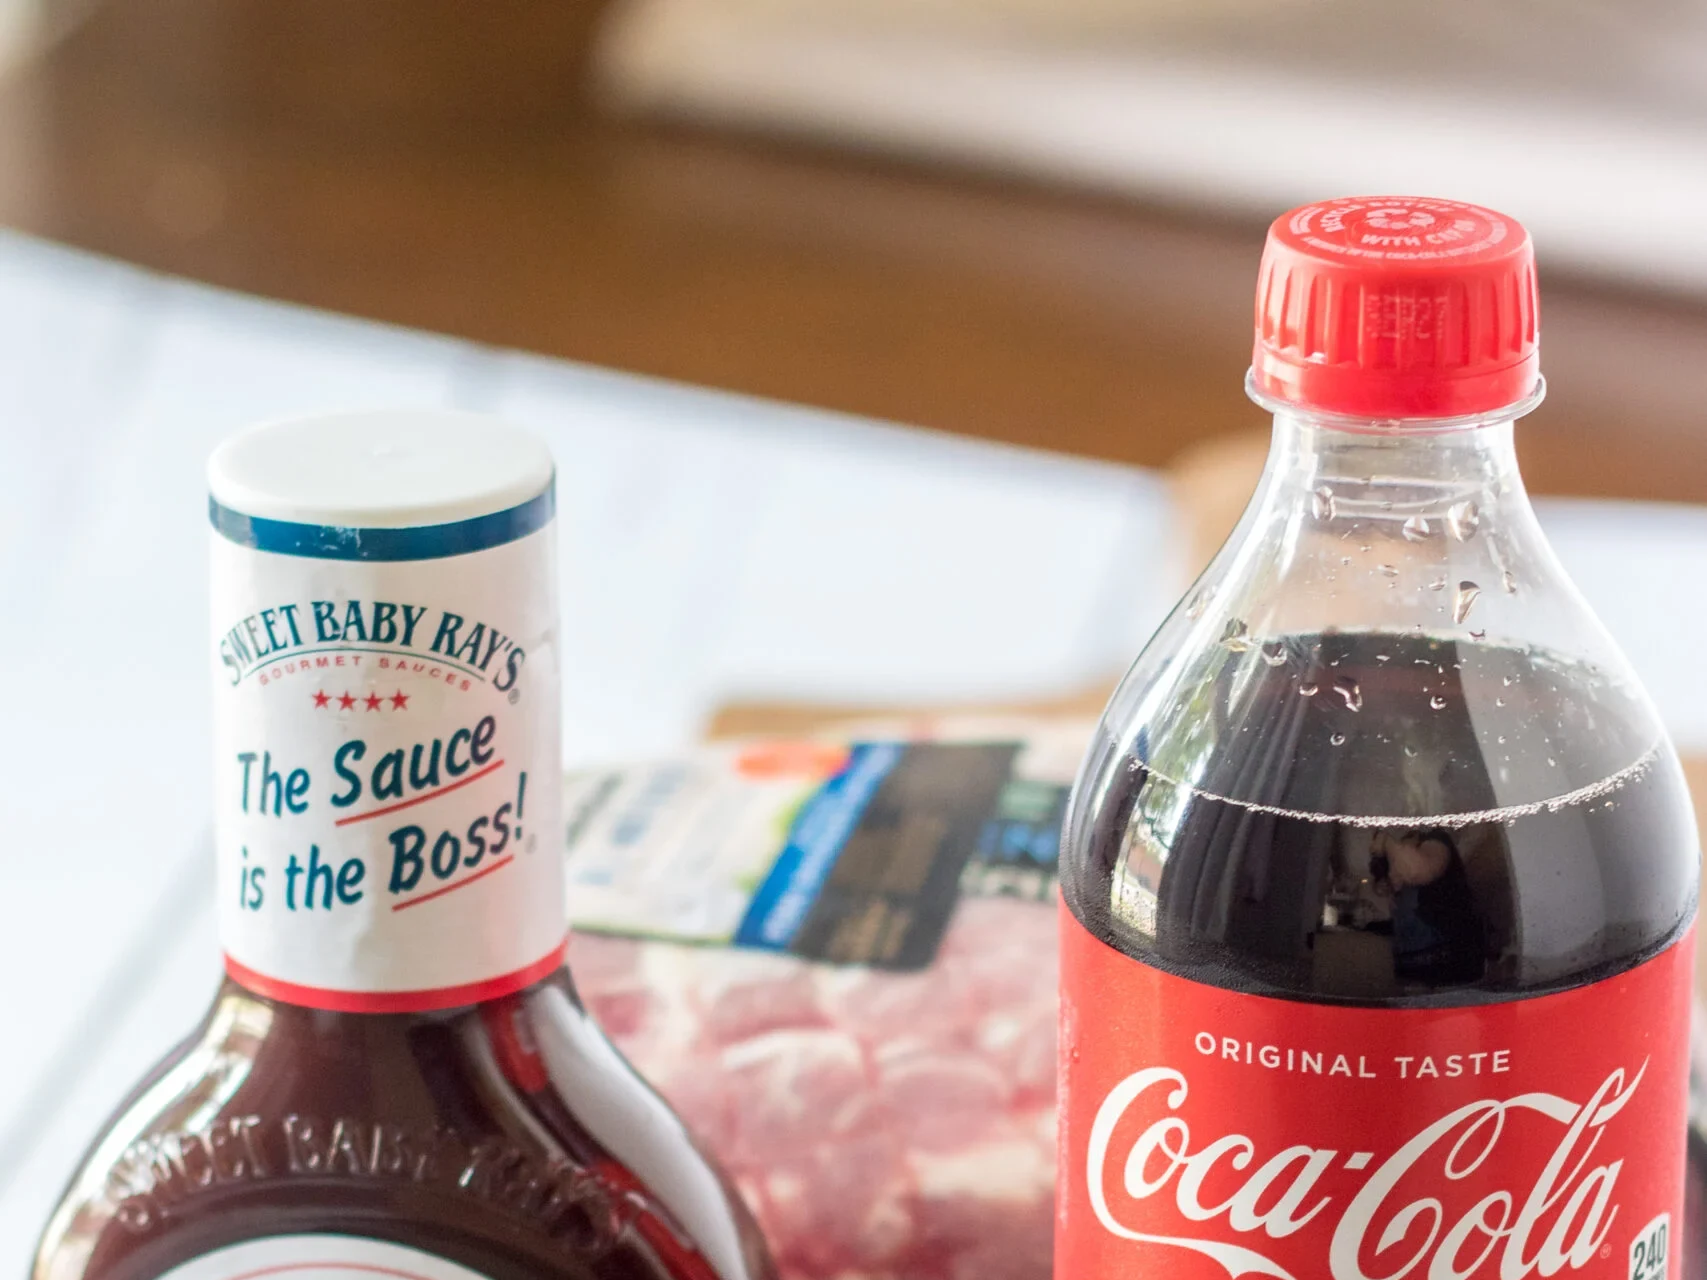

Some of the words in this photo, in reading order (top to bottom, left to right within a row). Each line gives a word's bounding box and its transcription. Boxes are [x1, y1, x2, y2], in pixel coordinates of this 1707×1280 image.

[1360, 233, 1421, 246] WITH
[219, 604, 302, 687] SWEET
[311, 599, 428, 647] BABY
[430, 612, 526, 696] RAY'S
[258, 654, 362, 686] GOURMET
[379, 657, 472, 692] SAUCES
[237, 751, 311, 818] The
[330, 715, 497, 809] Sauce
[240, 845, 266, 911] is
[284, 843, 366, 912] the
[387, 771, 527, 895] Boss!
[1194, 1031, 1377, 1078] ORIGINAL
[1394, 1049, 1512, 1079] TASTE
